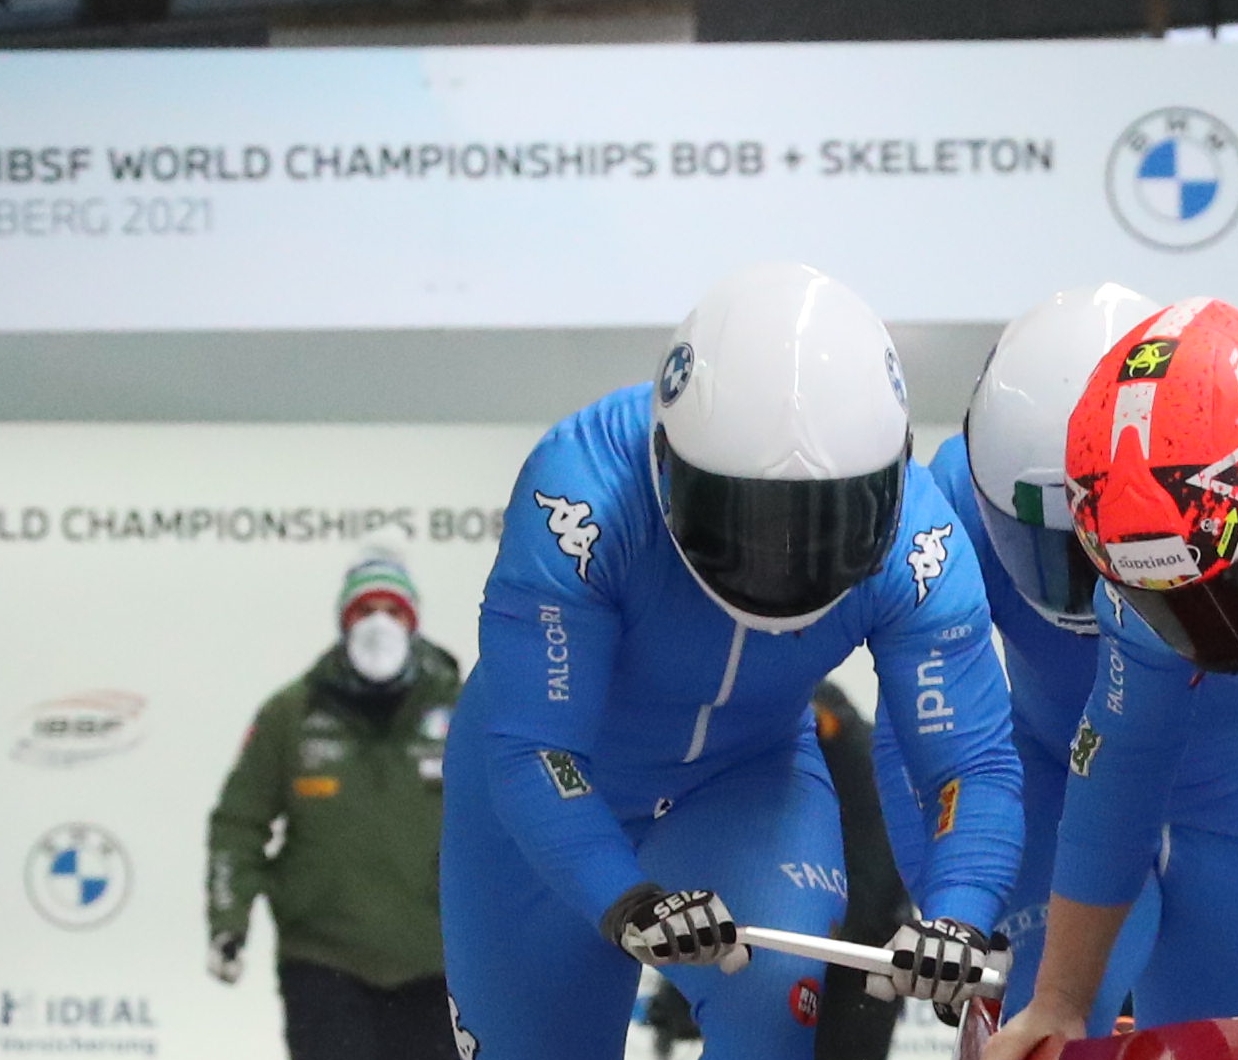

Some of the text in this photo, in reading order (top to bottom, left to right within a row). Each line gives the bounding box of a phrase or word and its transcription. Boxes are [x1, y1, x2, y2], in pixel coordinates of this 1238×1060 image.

[105, 145, 271, 183] WORLD
[284, 141, 655, 182] CHAMPIONSHIPS
[672, 141, 764, 177] BOB
[820, 137, 1055, 175] SKELETON
[0, 197, 212, 238] BERG 2021
[0, 507, 48, 541] LD
[61, 505, 416, 542] CHAMPIONSHIPS
[46, 995, 157, 1027] IDEAL
